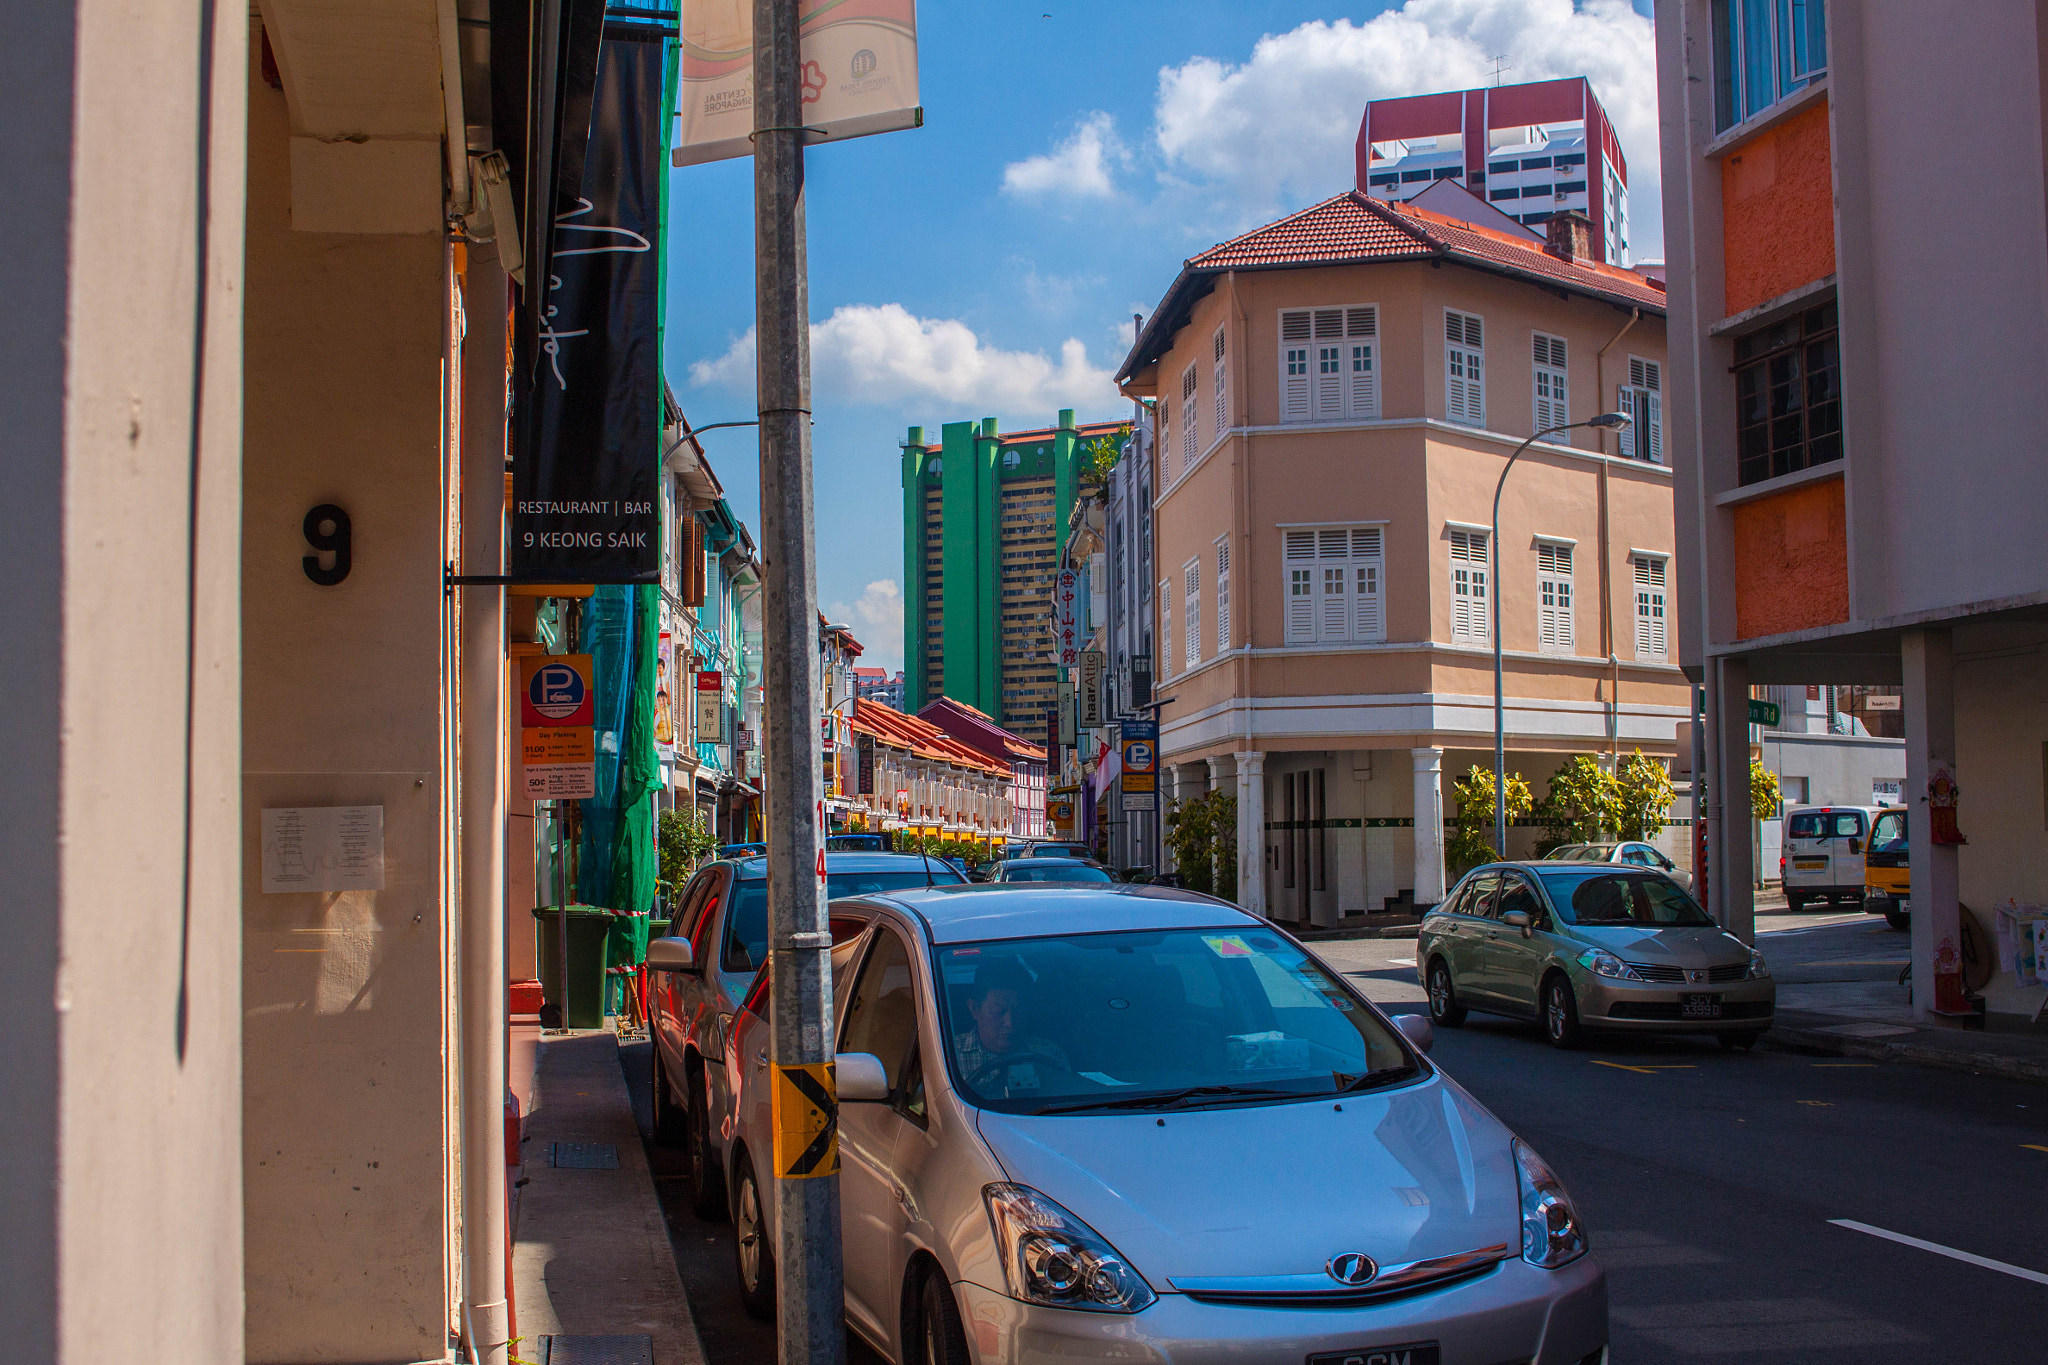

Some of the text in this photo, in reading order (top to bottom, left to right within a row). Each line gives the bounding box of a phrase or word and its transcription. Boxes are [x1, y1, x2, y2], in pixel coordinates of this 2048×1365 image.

[518, 501, 653, 514] RESTAURANT BAR
[302, 504, 352, 586] 9
[523, 532, 647, 548] 9 KEONG SAIK
[1060, 590, 1077, 665] 中山會館
[541, 669, 574, 703] P
[1085, 653, 1096, 722] haarAttic
[704, 708, 714, 732] 餐厅
[1763, 706, 1776, 722] Rd
[553, 731, 577, 739] Parking
[1131, 745, 1150, 763] P
[815, 848, 827, 884] 4
